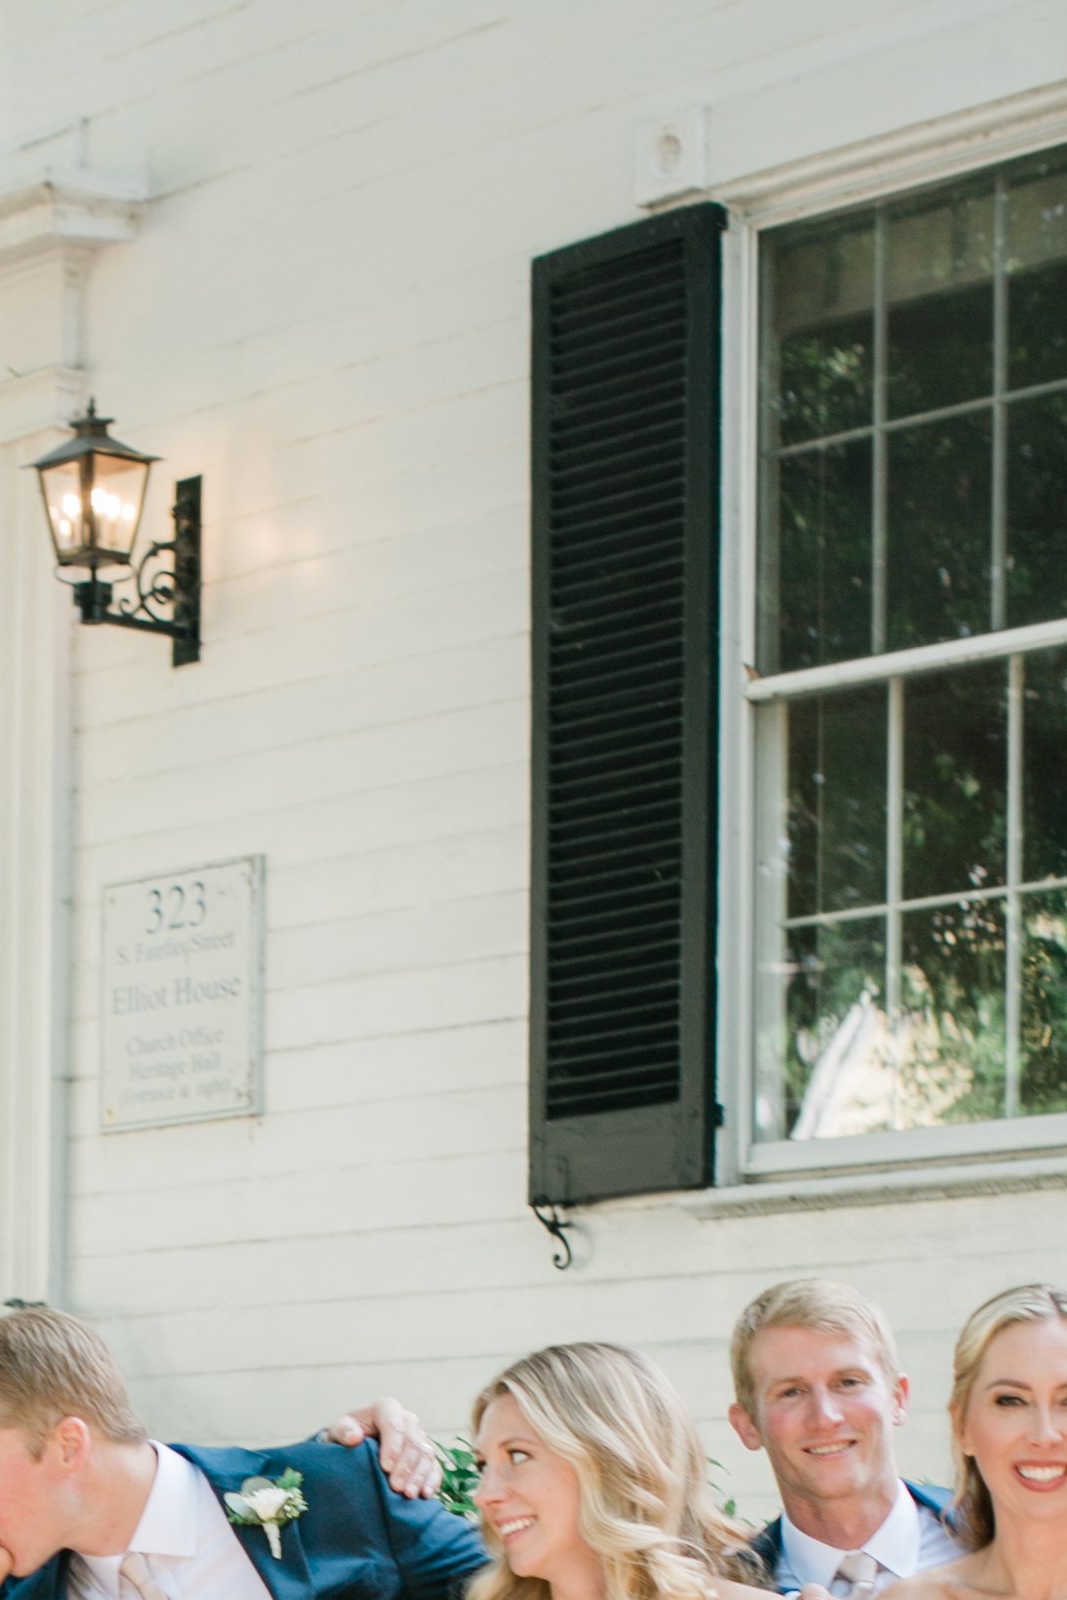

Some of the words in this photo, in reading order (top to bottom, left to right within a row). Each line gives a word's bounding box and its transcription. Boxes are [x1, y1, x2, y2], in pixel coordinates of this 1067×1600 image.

[145, 881, 208, 935] 323
[116, 944, 131, 967] S.
[191, 931, 235, 953] Street
[111, 984, 167, 1016] Elliot
[173, 976, 241, 1006] House
[125, 1031, 176, 1057] Church
[179, 1025, 225, 1049] Office
[190, 1051, 222, 1074] Hall
